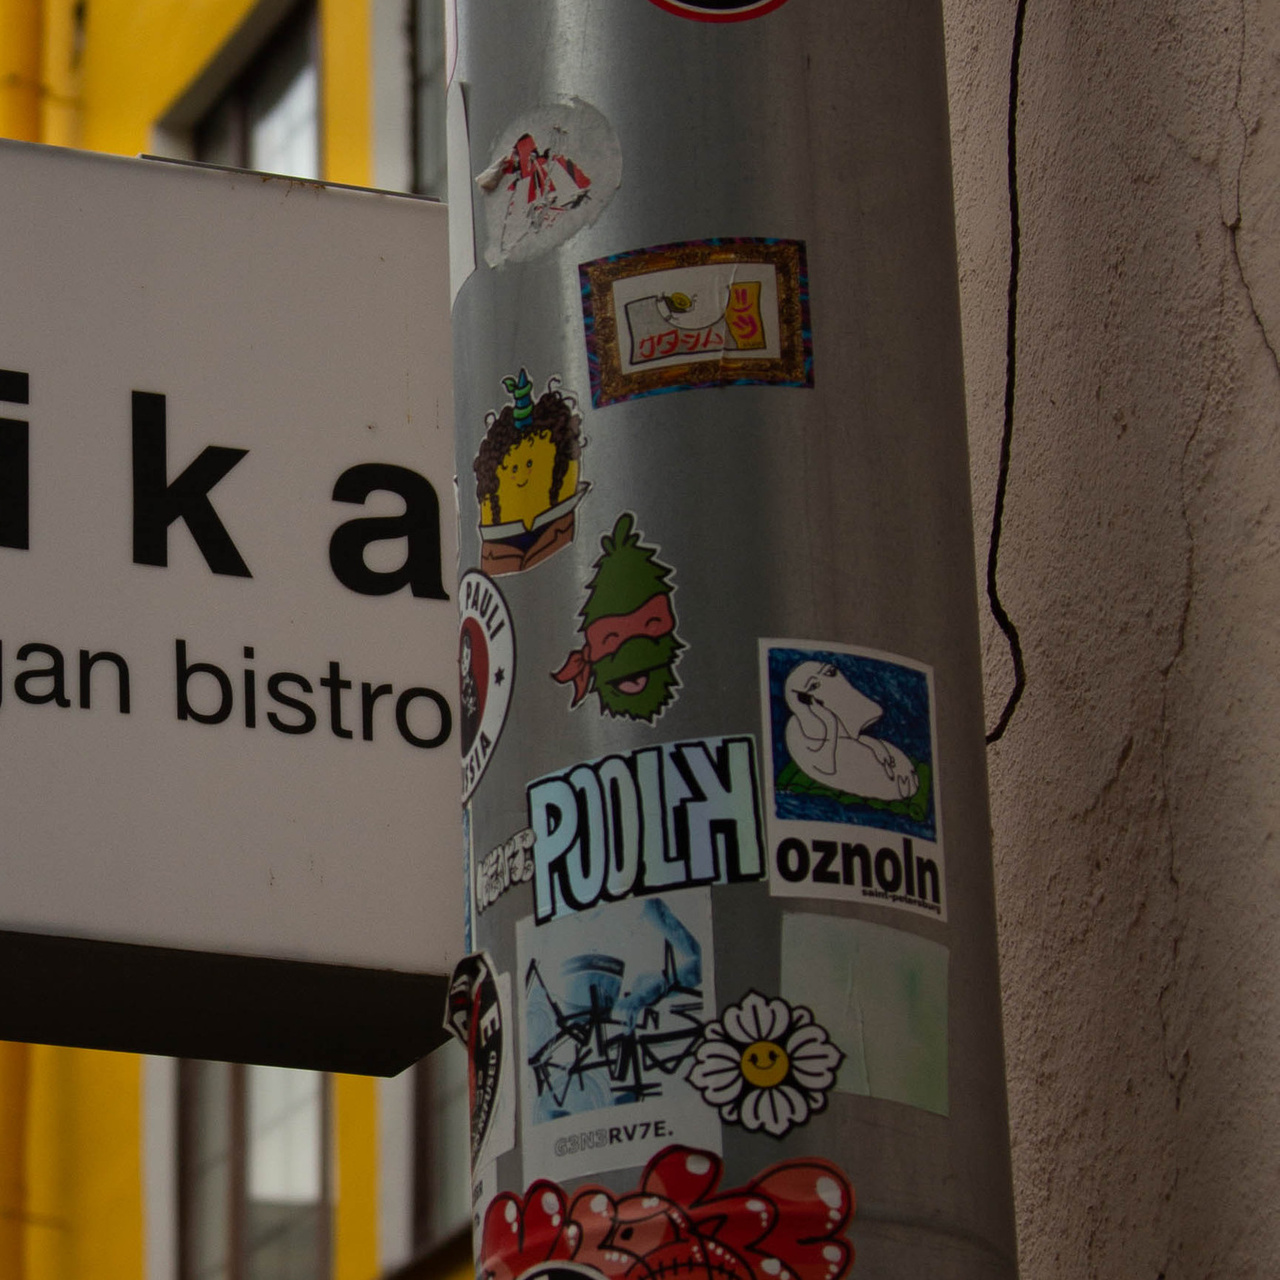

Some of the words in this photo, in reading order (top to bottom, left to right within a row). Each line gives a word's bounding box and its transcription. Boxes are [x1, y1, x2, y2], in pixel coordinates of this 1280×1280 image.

[466, 580, 506, 642] PAULI
[176, 639, 454, 750] bistro
[776, 837, 941, 904] oznoln
